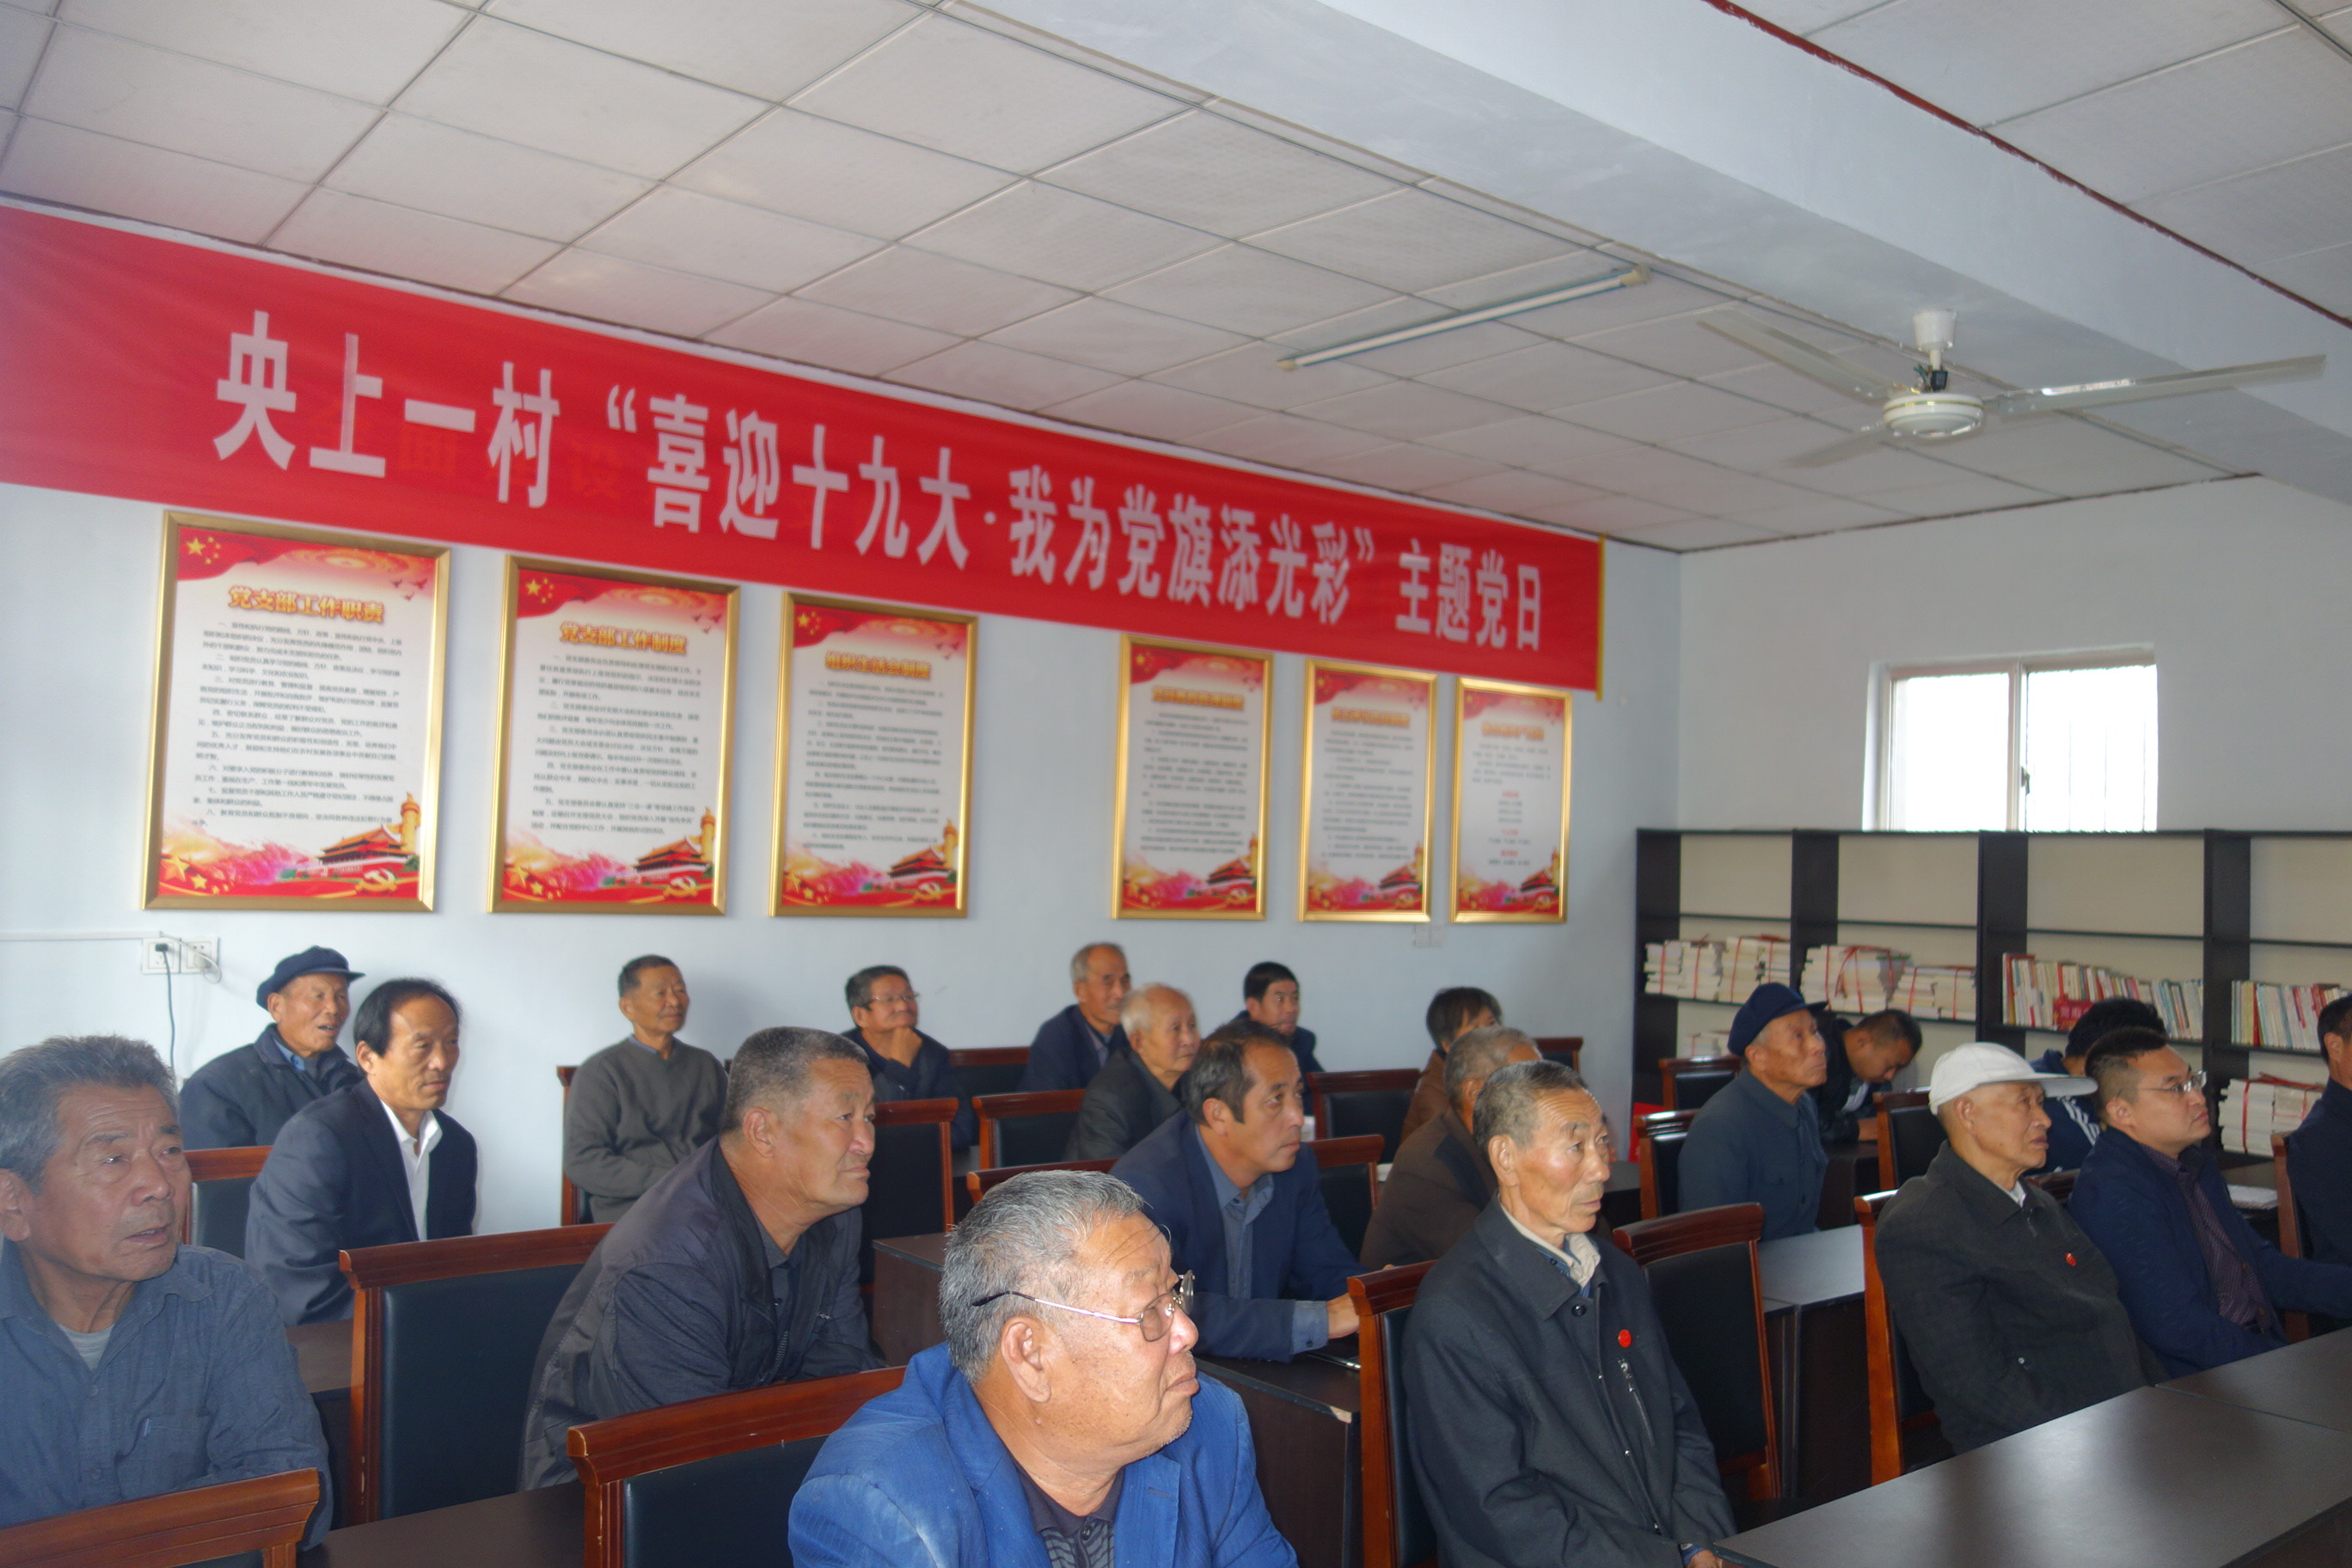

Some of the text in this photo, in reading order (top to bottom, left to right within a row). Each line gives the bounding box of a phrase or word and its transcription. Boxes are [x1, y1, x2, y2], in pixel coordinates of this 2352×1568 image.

[228, 585, 385, 624] 党支部工作职责
[560, 621, 687, 655] 党支部工作制度
